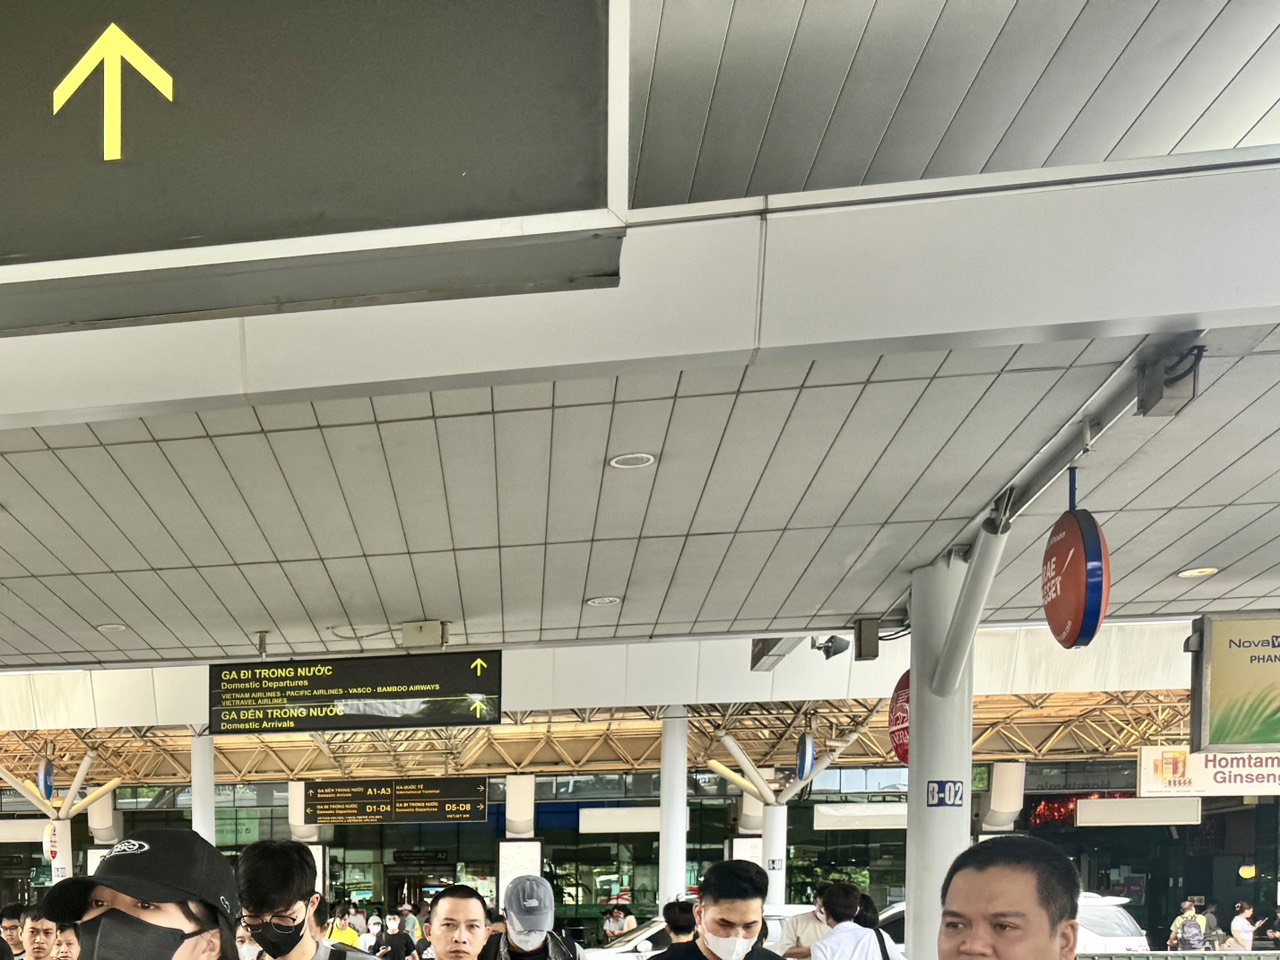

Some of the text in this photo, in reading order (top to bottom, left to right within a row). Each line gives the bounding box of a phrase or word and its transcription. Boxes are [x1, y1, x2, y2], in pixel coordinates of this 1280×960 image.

[221, 664, 333, 680] GA ĐI TRONG NƯỚC
[221, 680, 308, 690] Domestic Departures
[409, 684, 440, 692] AIRWAYS
[221, 711, 238, 720] GA
[266, 708, 306, 718] TRONG
[309, 705, 345, 716] NƯỚC
[221, 720, 295, 730] Domestic Arrivals
[928, 782, 963, 805] B-02
